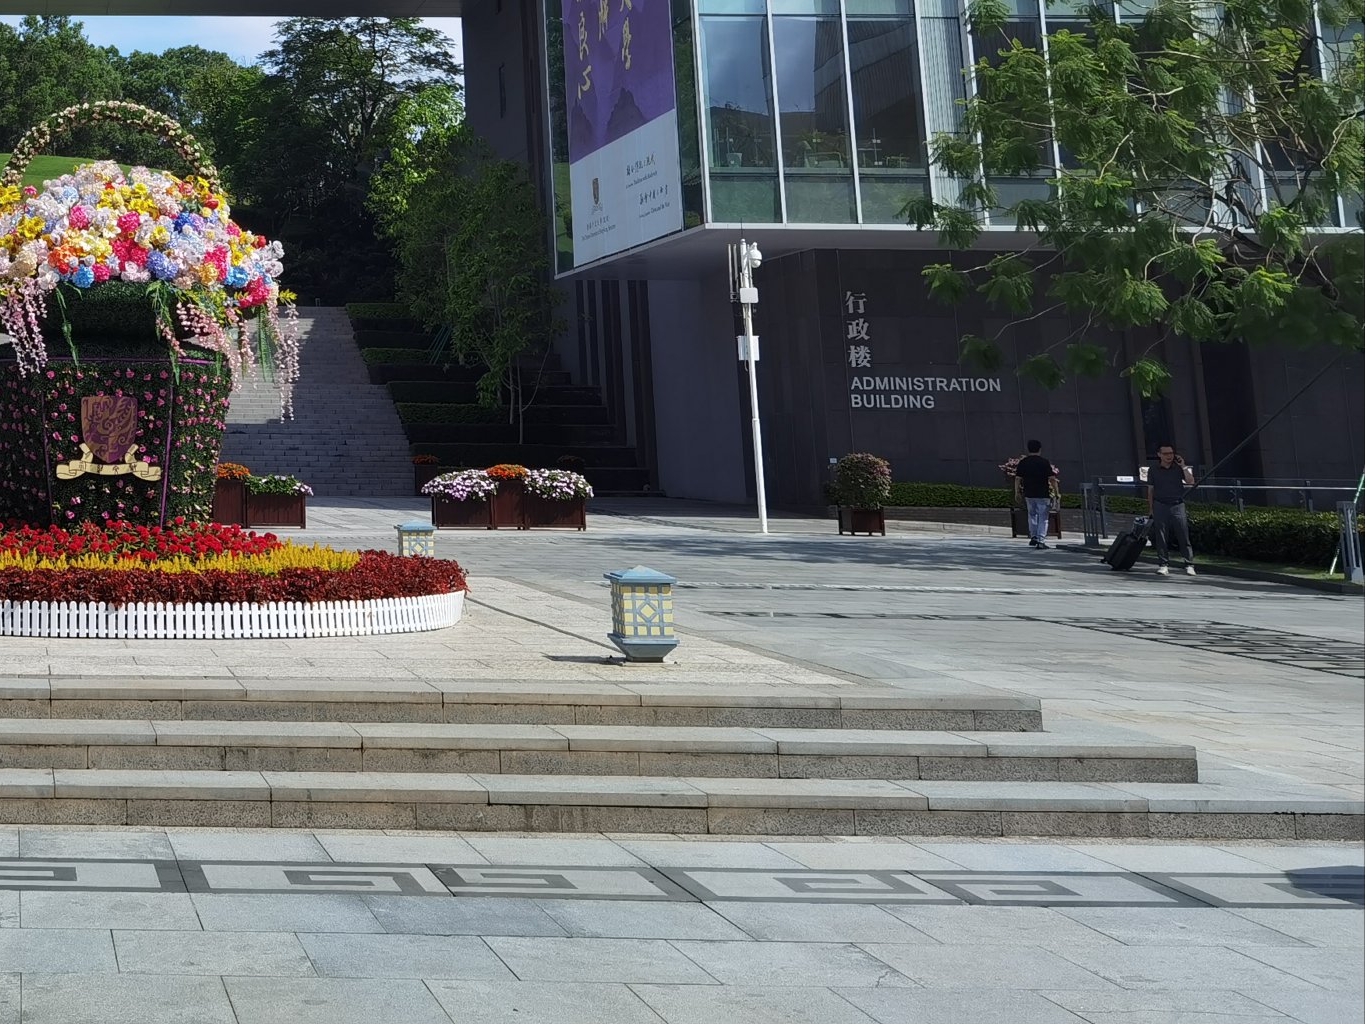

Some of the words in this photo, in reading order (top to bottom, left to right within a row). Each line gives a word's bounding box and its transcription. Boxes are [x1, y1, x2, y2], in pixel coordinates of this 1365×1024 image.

[845, 291, 872, 368] 行政楼
[850, 376, 1001, 392] ADMINISTRATION
[850, 394, 935, 409] BUILDING
